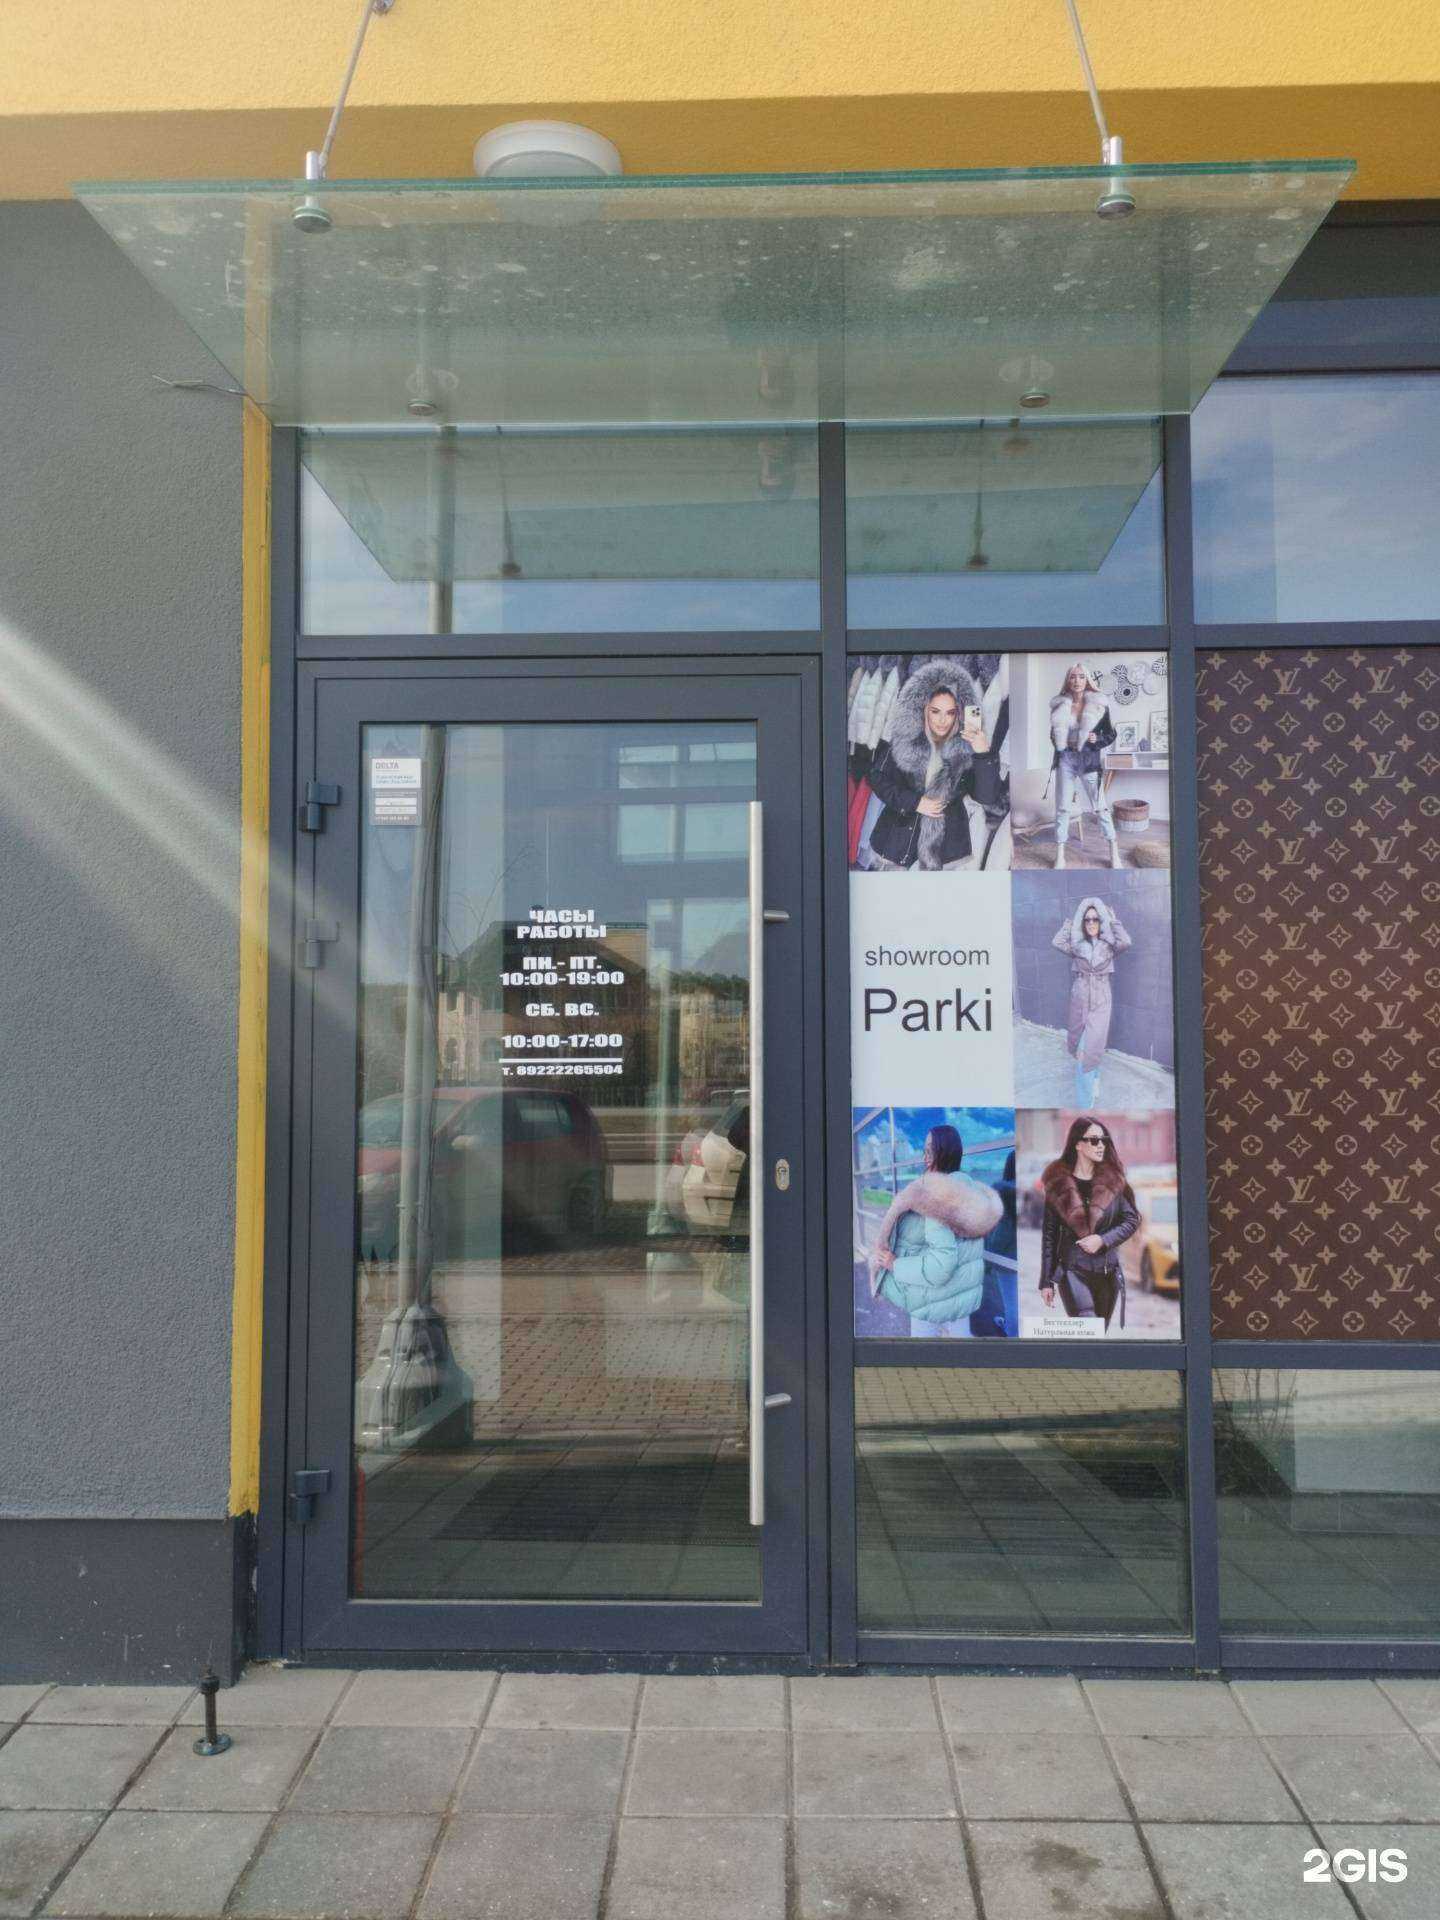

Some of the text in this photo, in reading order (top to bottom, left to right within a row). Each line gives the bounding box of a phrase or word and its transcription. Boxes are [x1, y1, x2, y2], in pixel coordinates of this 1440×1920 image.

[529, 909, 595, 923] ЧАСЫ
[516, 925, 607, 939] РАБОТЫ
[570, 956, 602, 969] ПТ.
[865, 945, 990, 966] showroom
[500, 971, 624, 986] 10:00-19:00
[525, 1002, 600, 1017] СБ. ВС.
[864, 988, 992, 1032] Parki
[501, 1034, 623, 1048] 10:00-17:00
[517, 1065, 623, 1076] 89222265504
